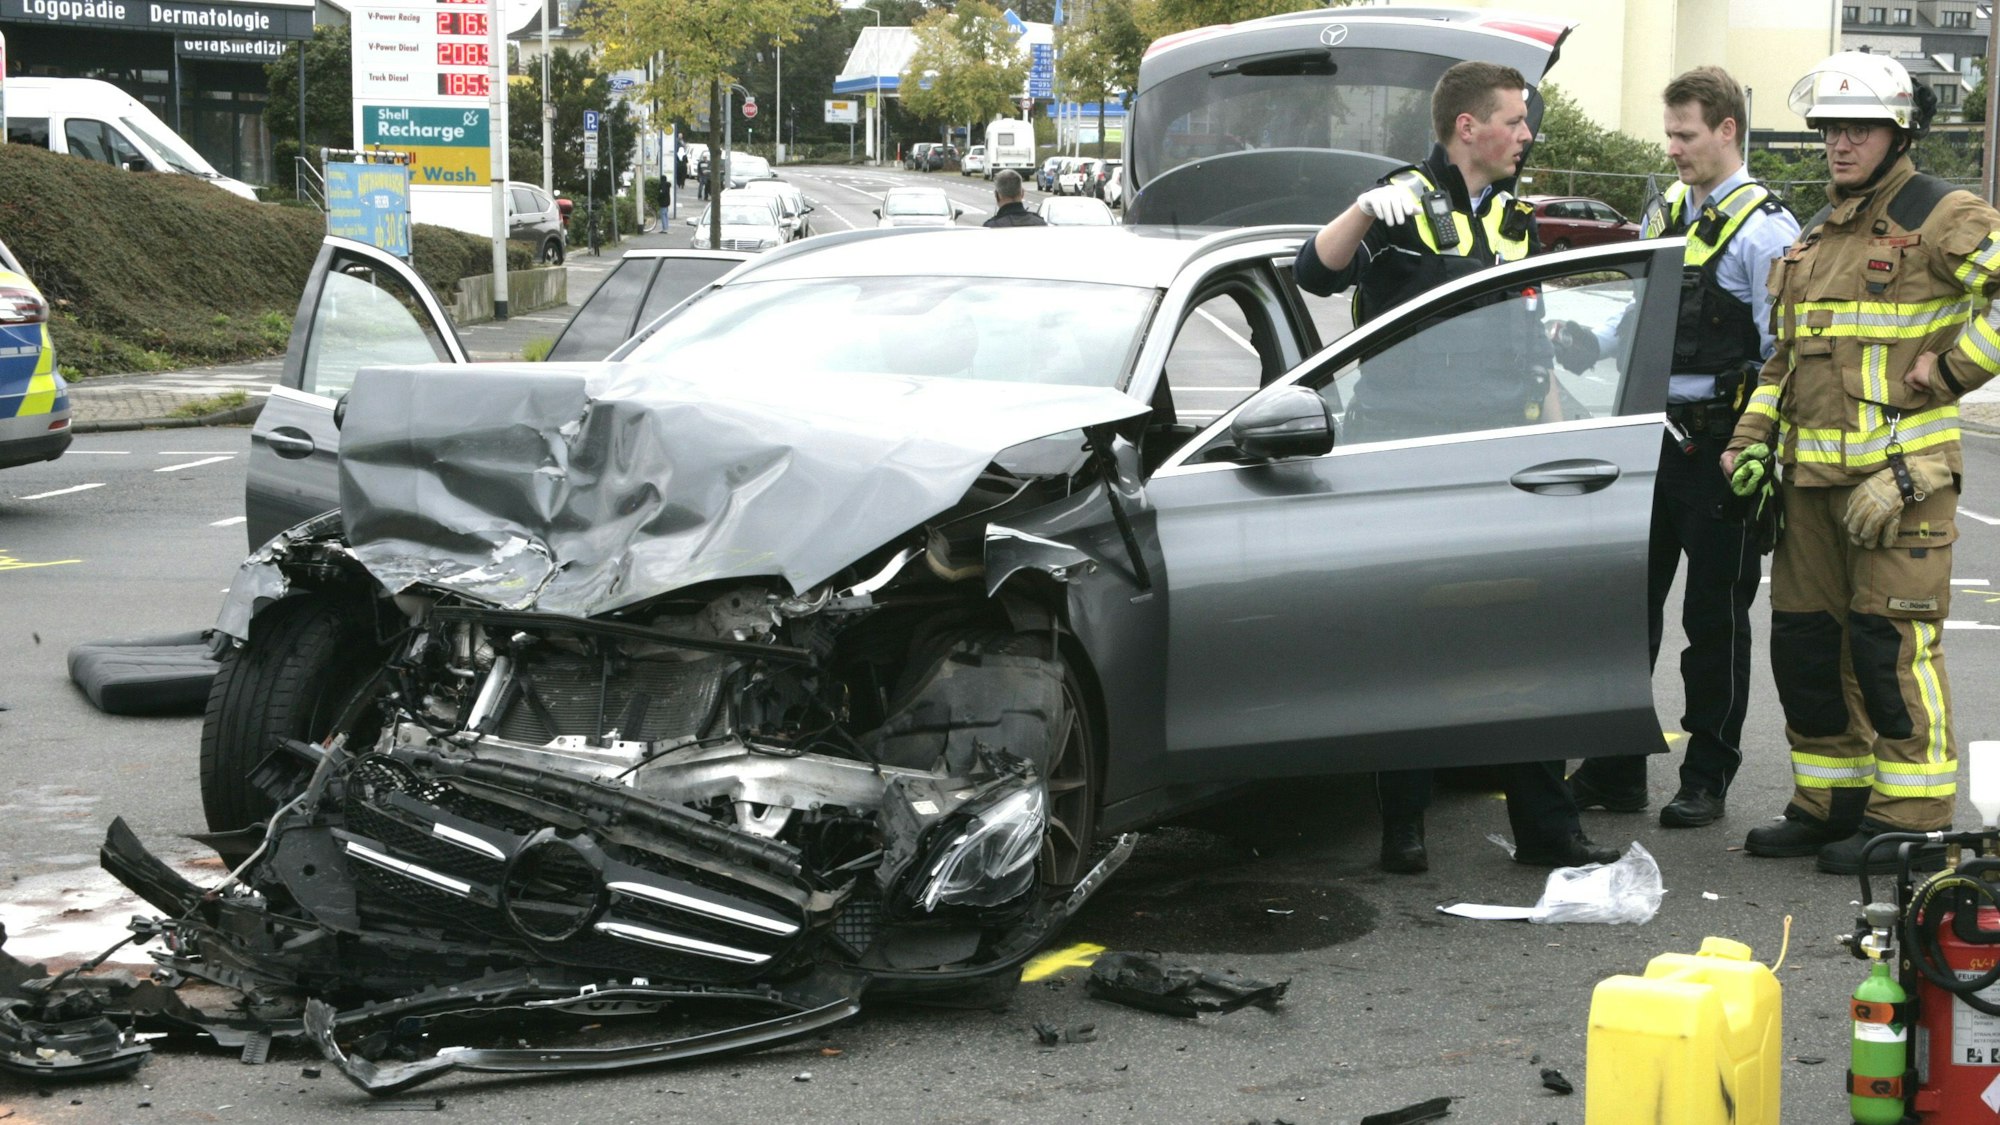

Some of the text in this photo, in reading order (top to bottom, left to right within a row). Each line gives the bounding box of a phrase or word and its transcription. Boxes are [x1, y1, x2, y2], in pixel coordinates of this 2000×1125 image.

[23, 0, 125, 20] Logopädie
[368, 12, 396, 20] V-Power
[151, 5, 270, 31] Dermatologie
[368, 43, 419, 52] V-Power Diesel
[369, 73, 409, 82] Truck Diesel
[1840, 79, 1849, 91] A
[378, 109, 409, 121] Shell
[378, 121, 465, 141] Recharge
[422, 166, 476, 182] Wash
